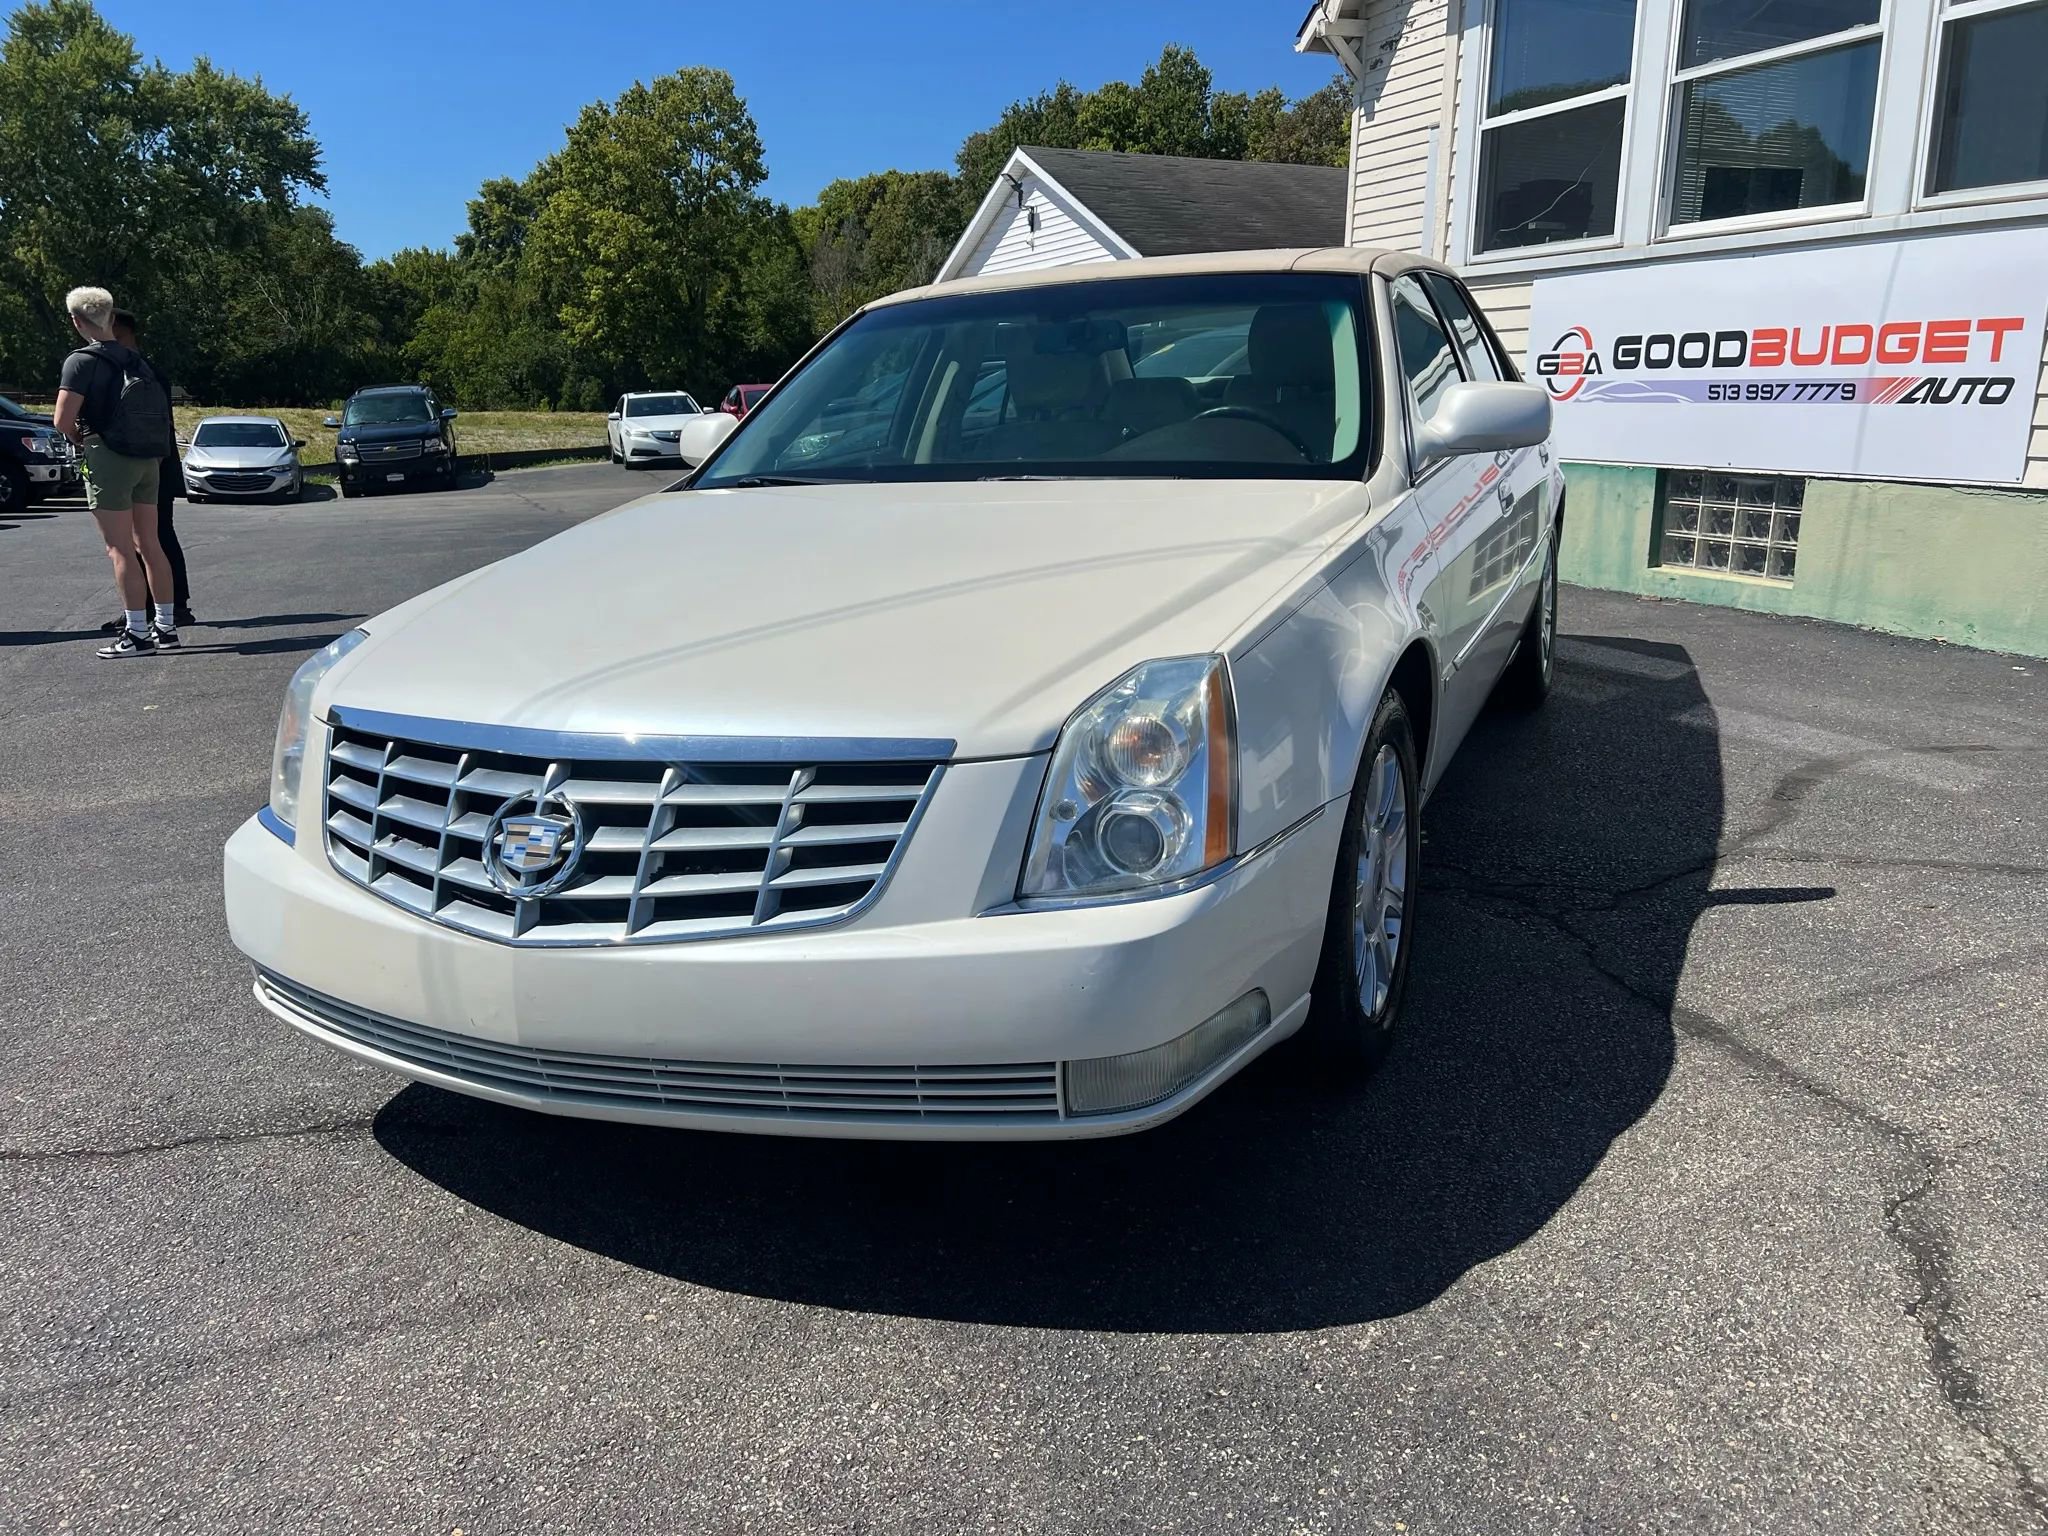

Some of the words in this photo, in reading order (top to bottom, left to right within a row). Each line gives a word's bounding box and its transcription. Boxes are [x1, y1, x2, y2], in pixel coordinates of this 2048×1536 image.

[1536, 351, 1603, 376] GBA
[1707, 383, 1741, 401] 513
[1745, 383, 1790, 401] 997
[1791, 382, 1857, 401] 7779
[1895, 376, 2016, 405] AUTO
